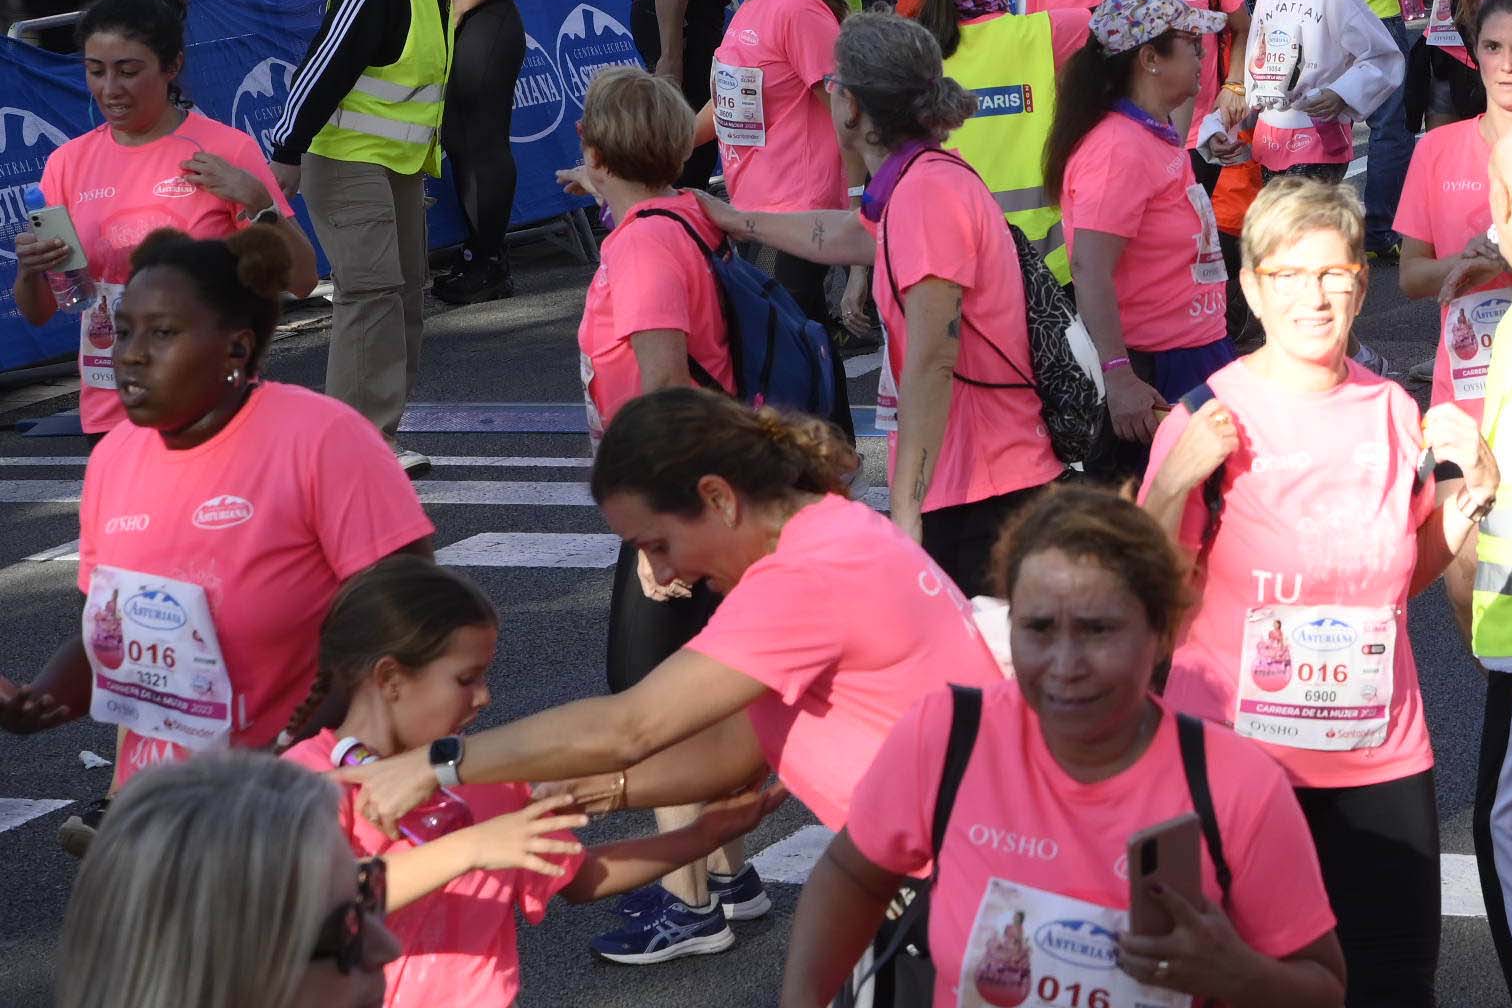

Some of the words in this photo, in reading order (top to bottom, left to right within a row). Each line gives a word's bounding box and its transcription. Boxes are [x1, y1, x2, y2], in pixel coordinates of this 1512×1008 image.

[1267, 53, 1285, 63] 016
[977, 93, 1020, 110] TARIS
[1475, 309, 1505, 320] ASTURIA
[1252, 570, 1302, 603] TU
[129, 640, 176, 668] 016
[1298, 663, 1348, 683] 016
[1305, 690, 1337, 703] 6900
[1256, 704, 1300, 716] CARRERA
[1302, 708, 1314, 717] DE
[1317, 709, 1328, 718] LA
[1330, 710, 1358, 719] MUJER
[1250, 720, 1298, 737] OYSHO
[969, 823, 1058, 860] OYSHO
[1037, 975, 1111, 1008] 016
